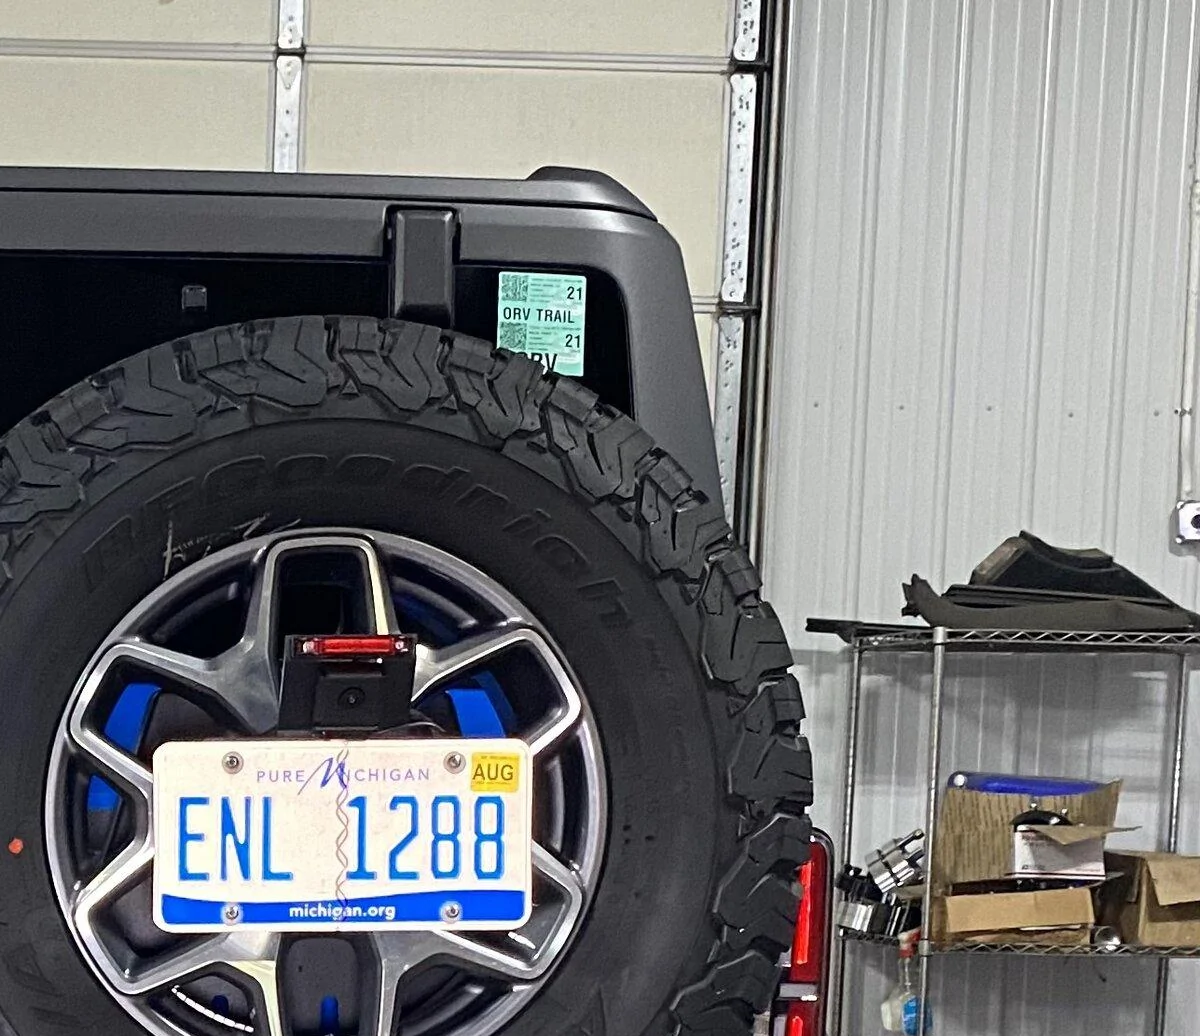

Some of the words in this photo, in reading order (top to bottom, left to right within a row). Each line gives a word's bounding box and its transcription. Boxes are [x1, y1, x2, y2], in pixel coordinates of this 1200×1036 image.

[566, 286, 582, 300] 21
[503, 307, 531, 321] ORV
[536, 308, 575, 323] TRAIL
[565, 334, 580, 348] 21
[256, 770, 305, 783] PURE
[472, 763, 514, 781] AUG
[178, 796, 294, 881] ENL
[346, 795, 506, 881] 1288
[289, 905, 396, 920] michigan.org
